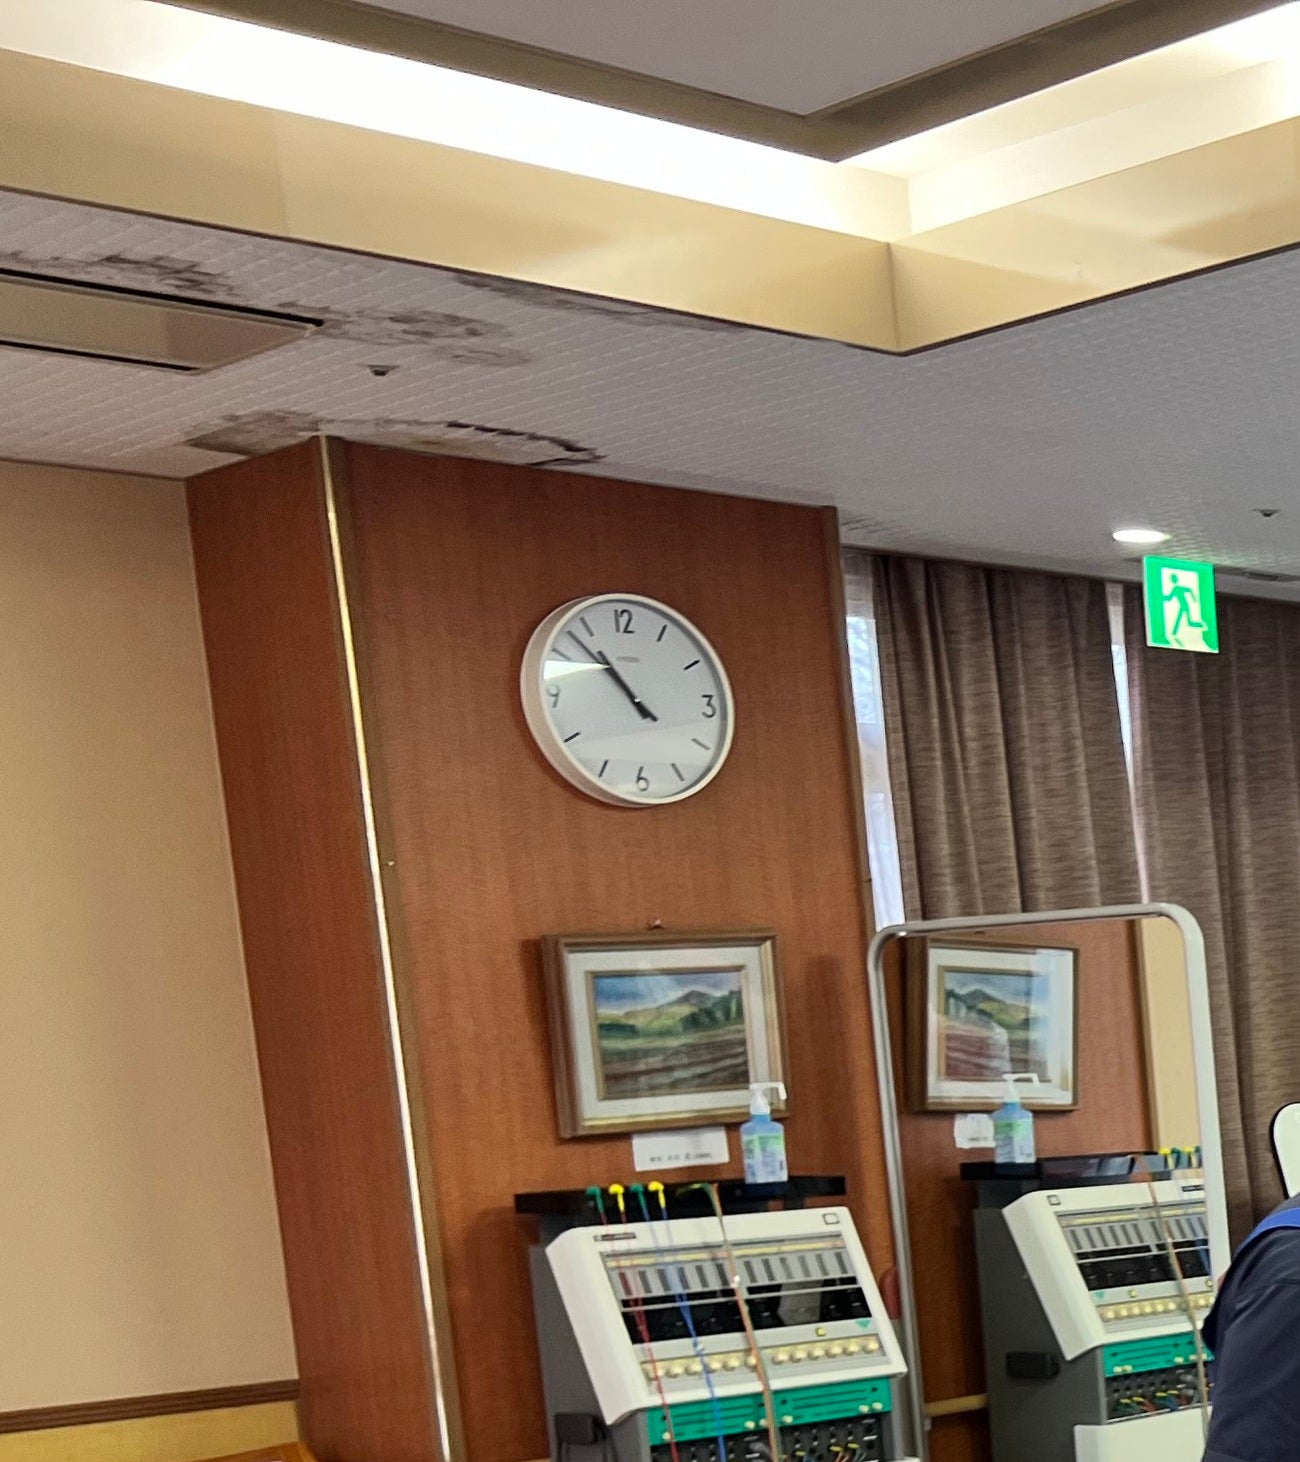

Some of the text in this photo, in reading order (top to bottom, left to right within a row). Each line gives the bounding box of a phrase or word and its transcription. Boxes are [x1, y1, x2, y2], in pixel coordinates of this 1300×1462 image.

[614, 609, 635, 633] 12
[546, 684, 560, 708] 9
[702, 695, 716, 718] 3
[636, 766, 649, 791] 6
